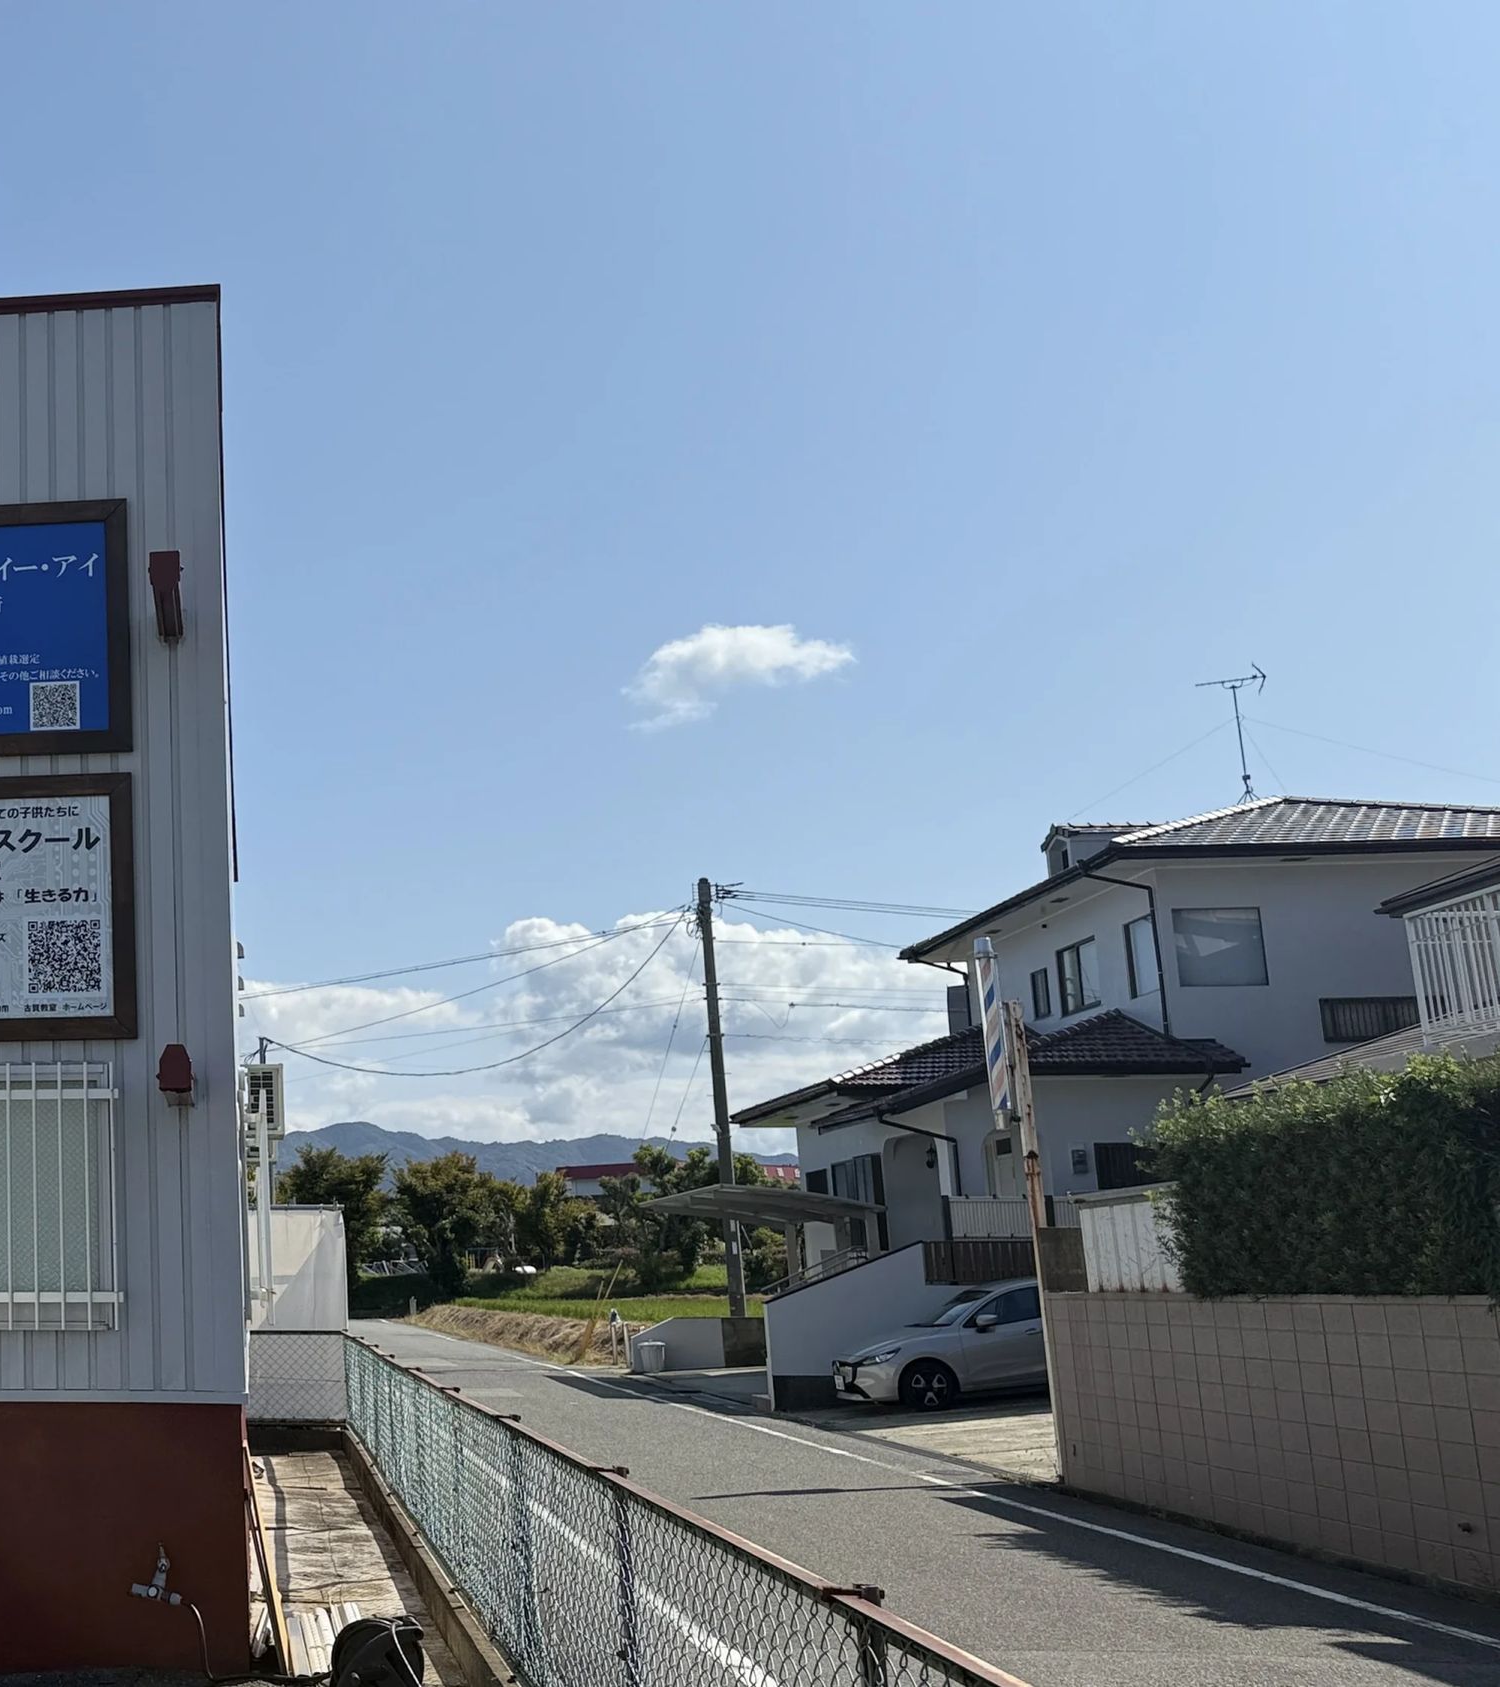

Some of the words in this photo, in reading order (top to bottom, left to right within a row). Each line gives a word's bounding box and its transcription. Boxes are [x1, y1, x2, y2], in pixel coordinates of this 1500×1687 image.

[15, 887, 99, 904] 「生きる力」
[23, 1003, 58, 1013] 古賀教室
[62, 1001, 108, 1012] ホームページ
